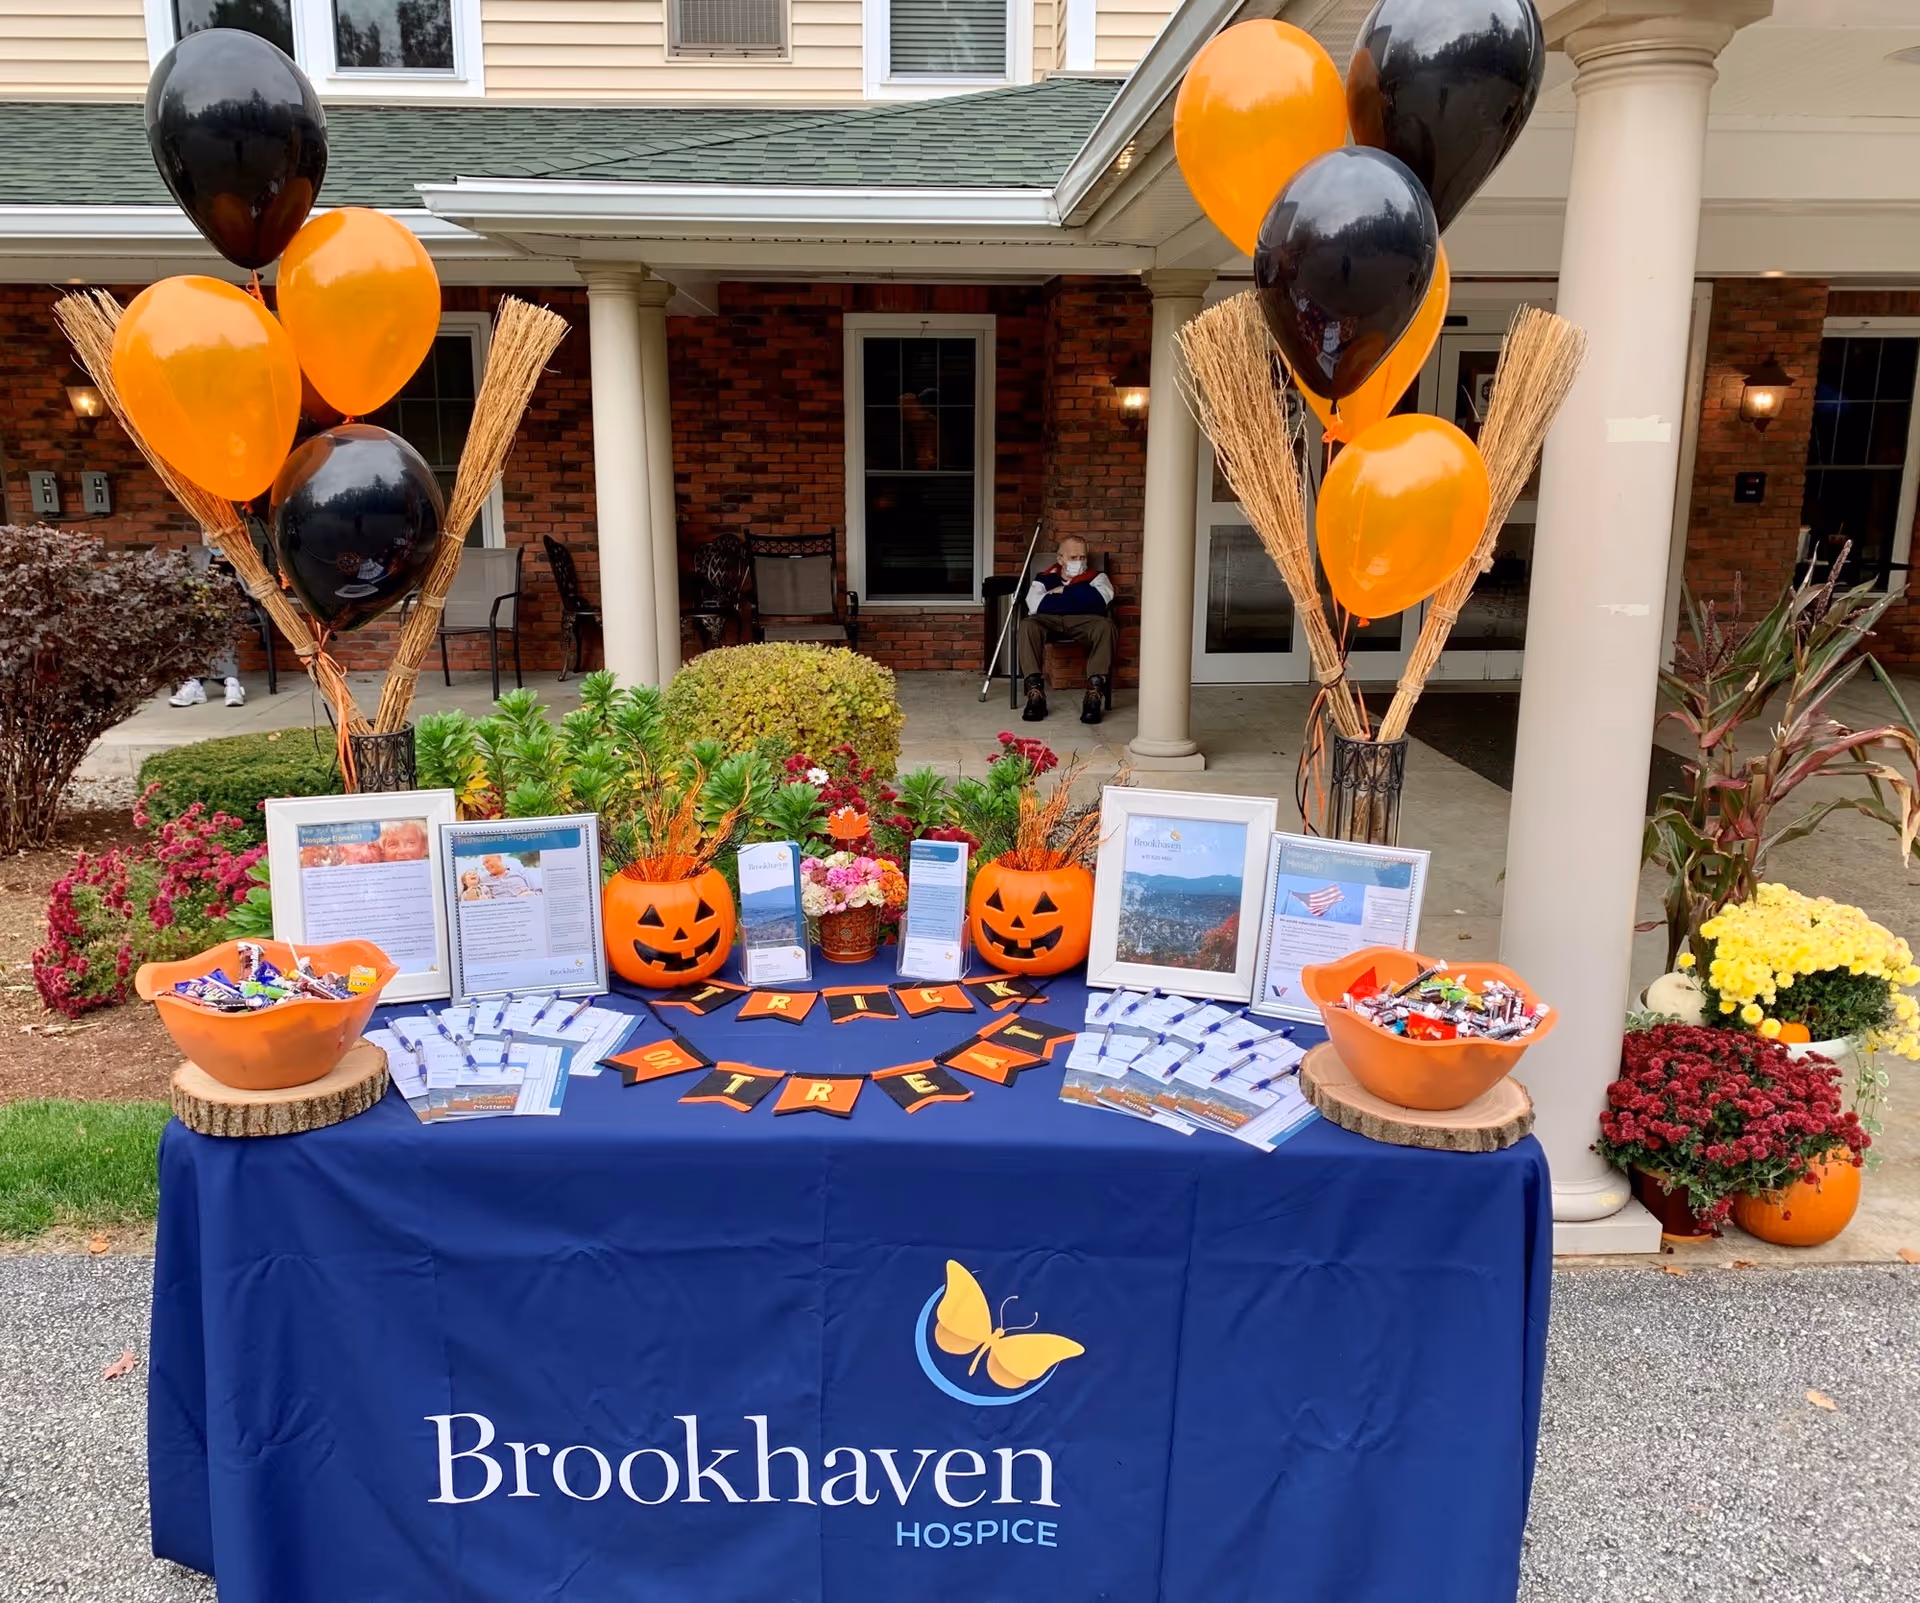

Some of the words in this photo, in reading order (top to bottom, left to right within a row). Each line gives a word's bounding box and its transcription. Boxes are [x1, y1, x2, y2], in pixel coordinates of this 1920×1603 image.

[506, 831, 546, 842] Program
[1134, 837, 1181, 850] Brookhaven
[423, 1412, 1061, 1508] Brookhaven
[896, 1518, 1058, 1548] HOSPICE
